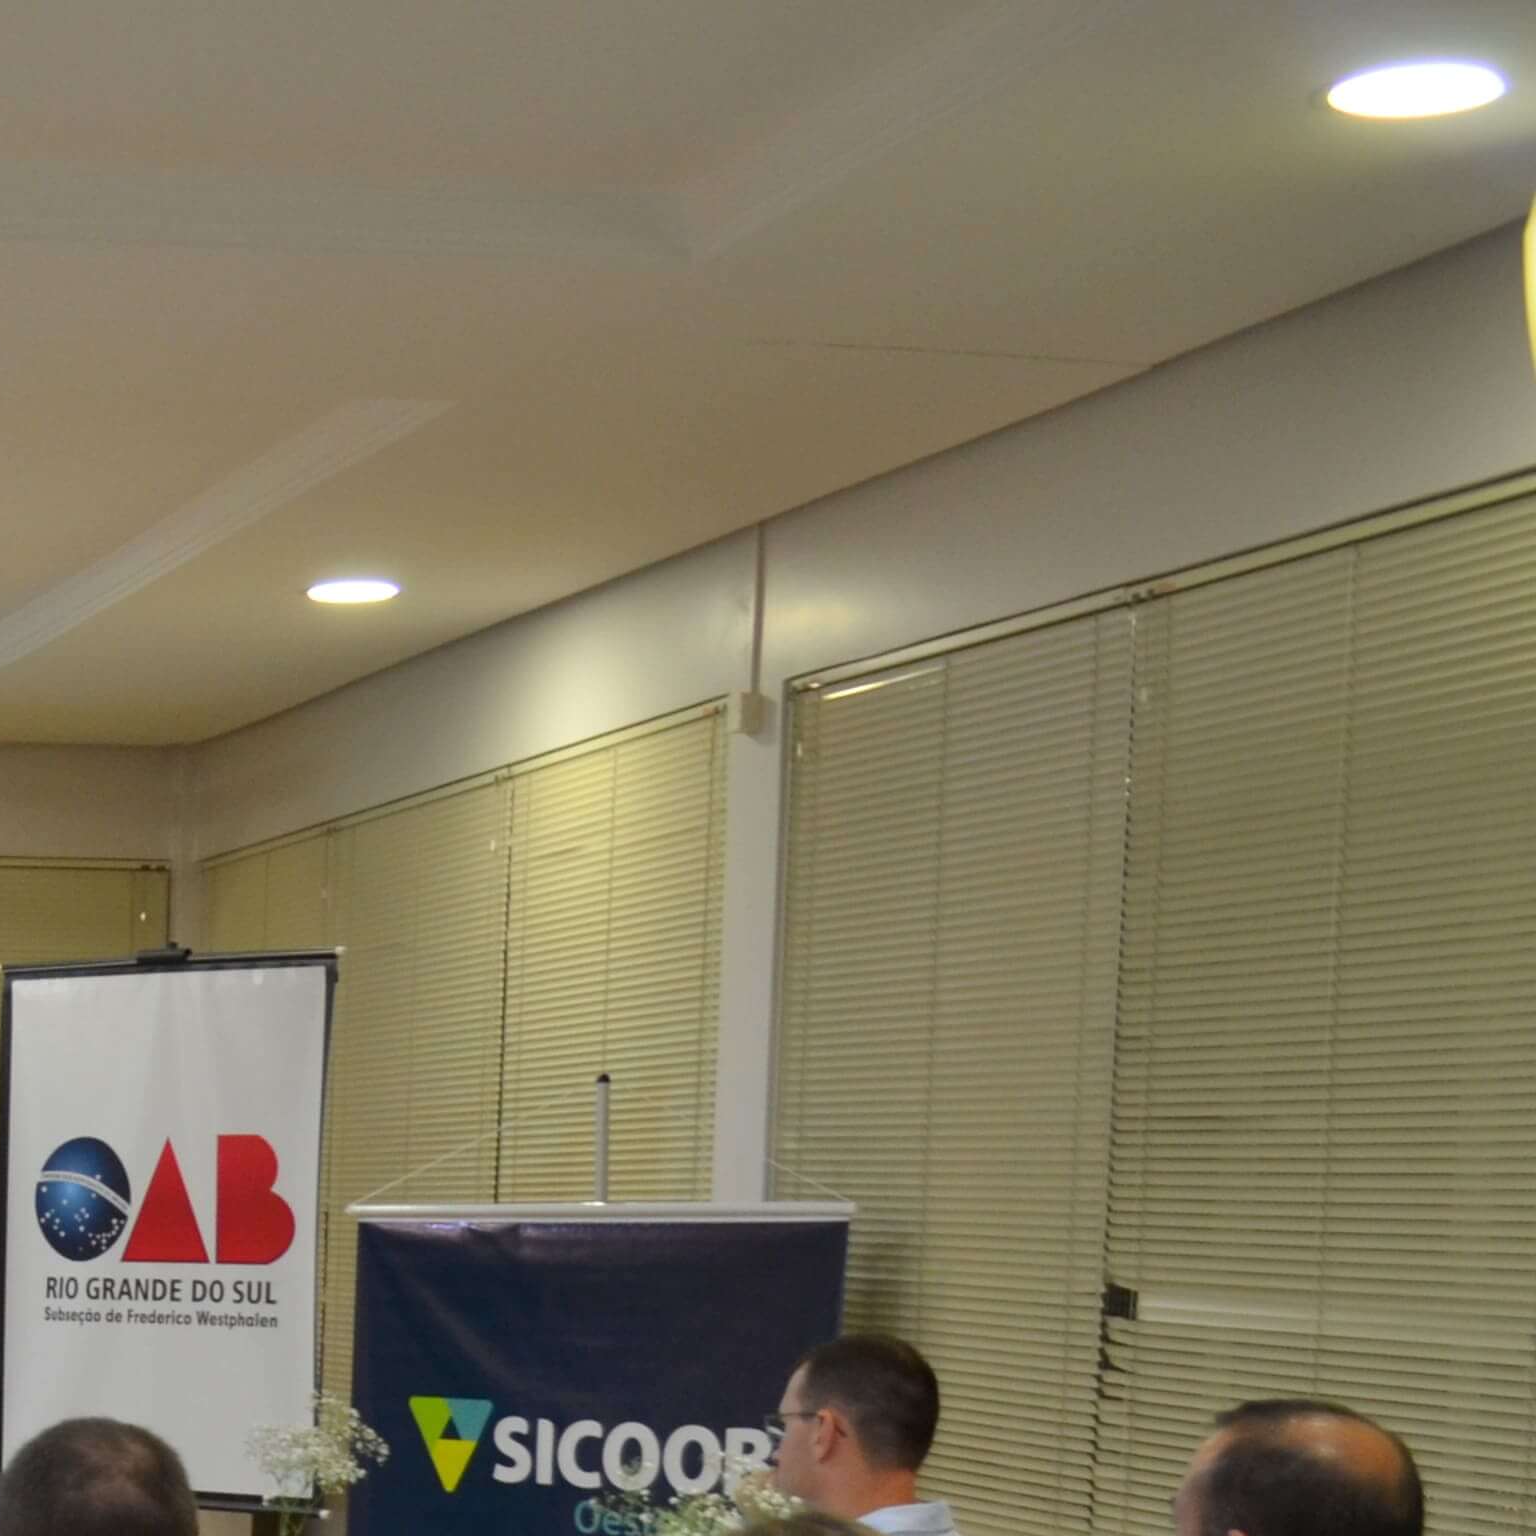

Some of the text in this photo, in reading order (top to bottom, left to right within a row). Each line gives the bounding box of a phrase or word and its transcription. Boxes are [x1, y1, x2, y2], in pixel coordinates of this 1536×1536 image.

[45, 1277, 277, 1304] RIO GRANDE DO SUL
[44, 1307, 278, 1329] Subseção de Frederico Westphalen
